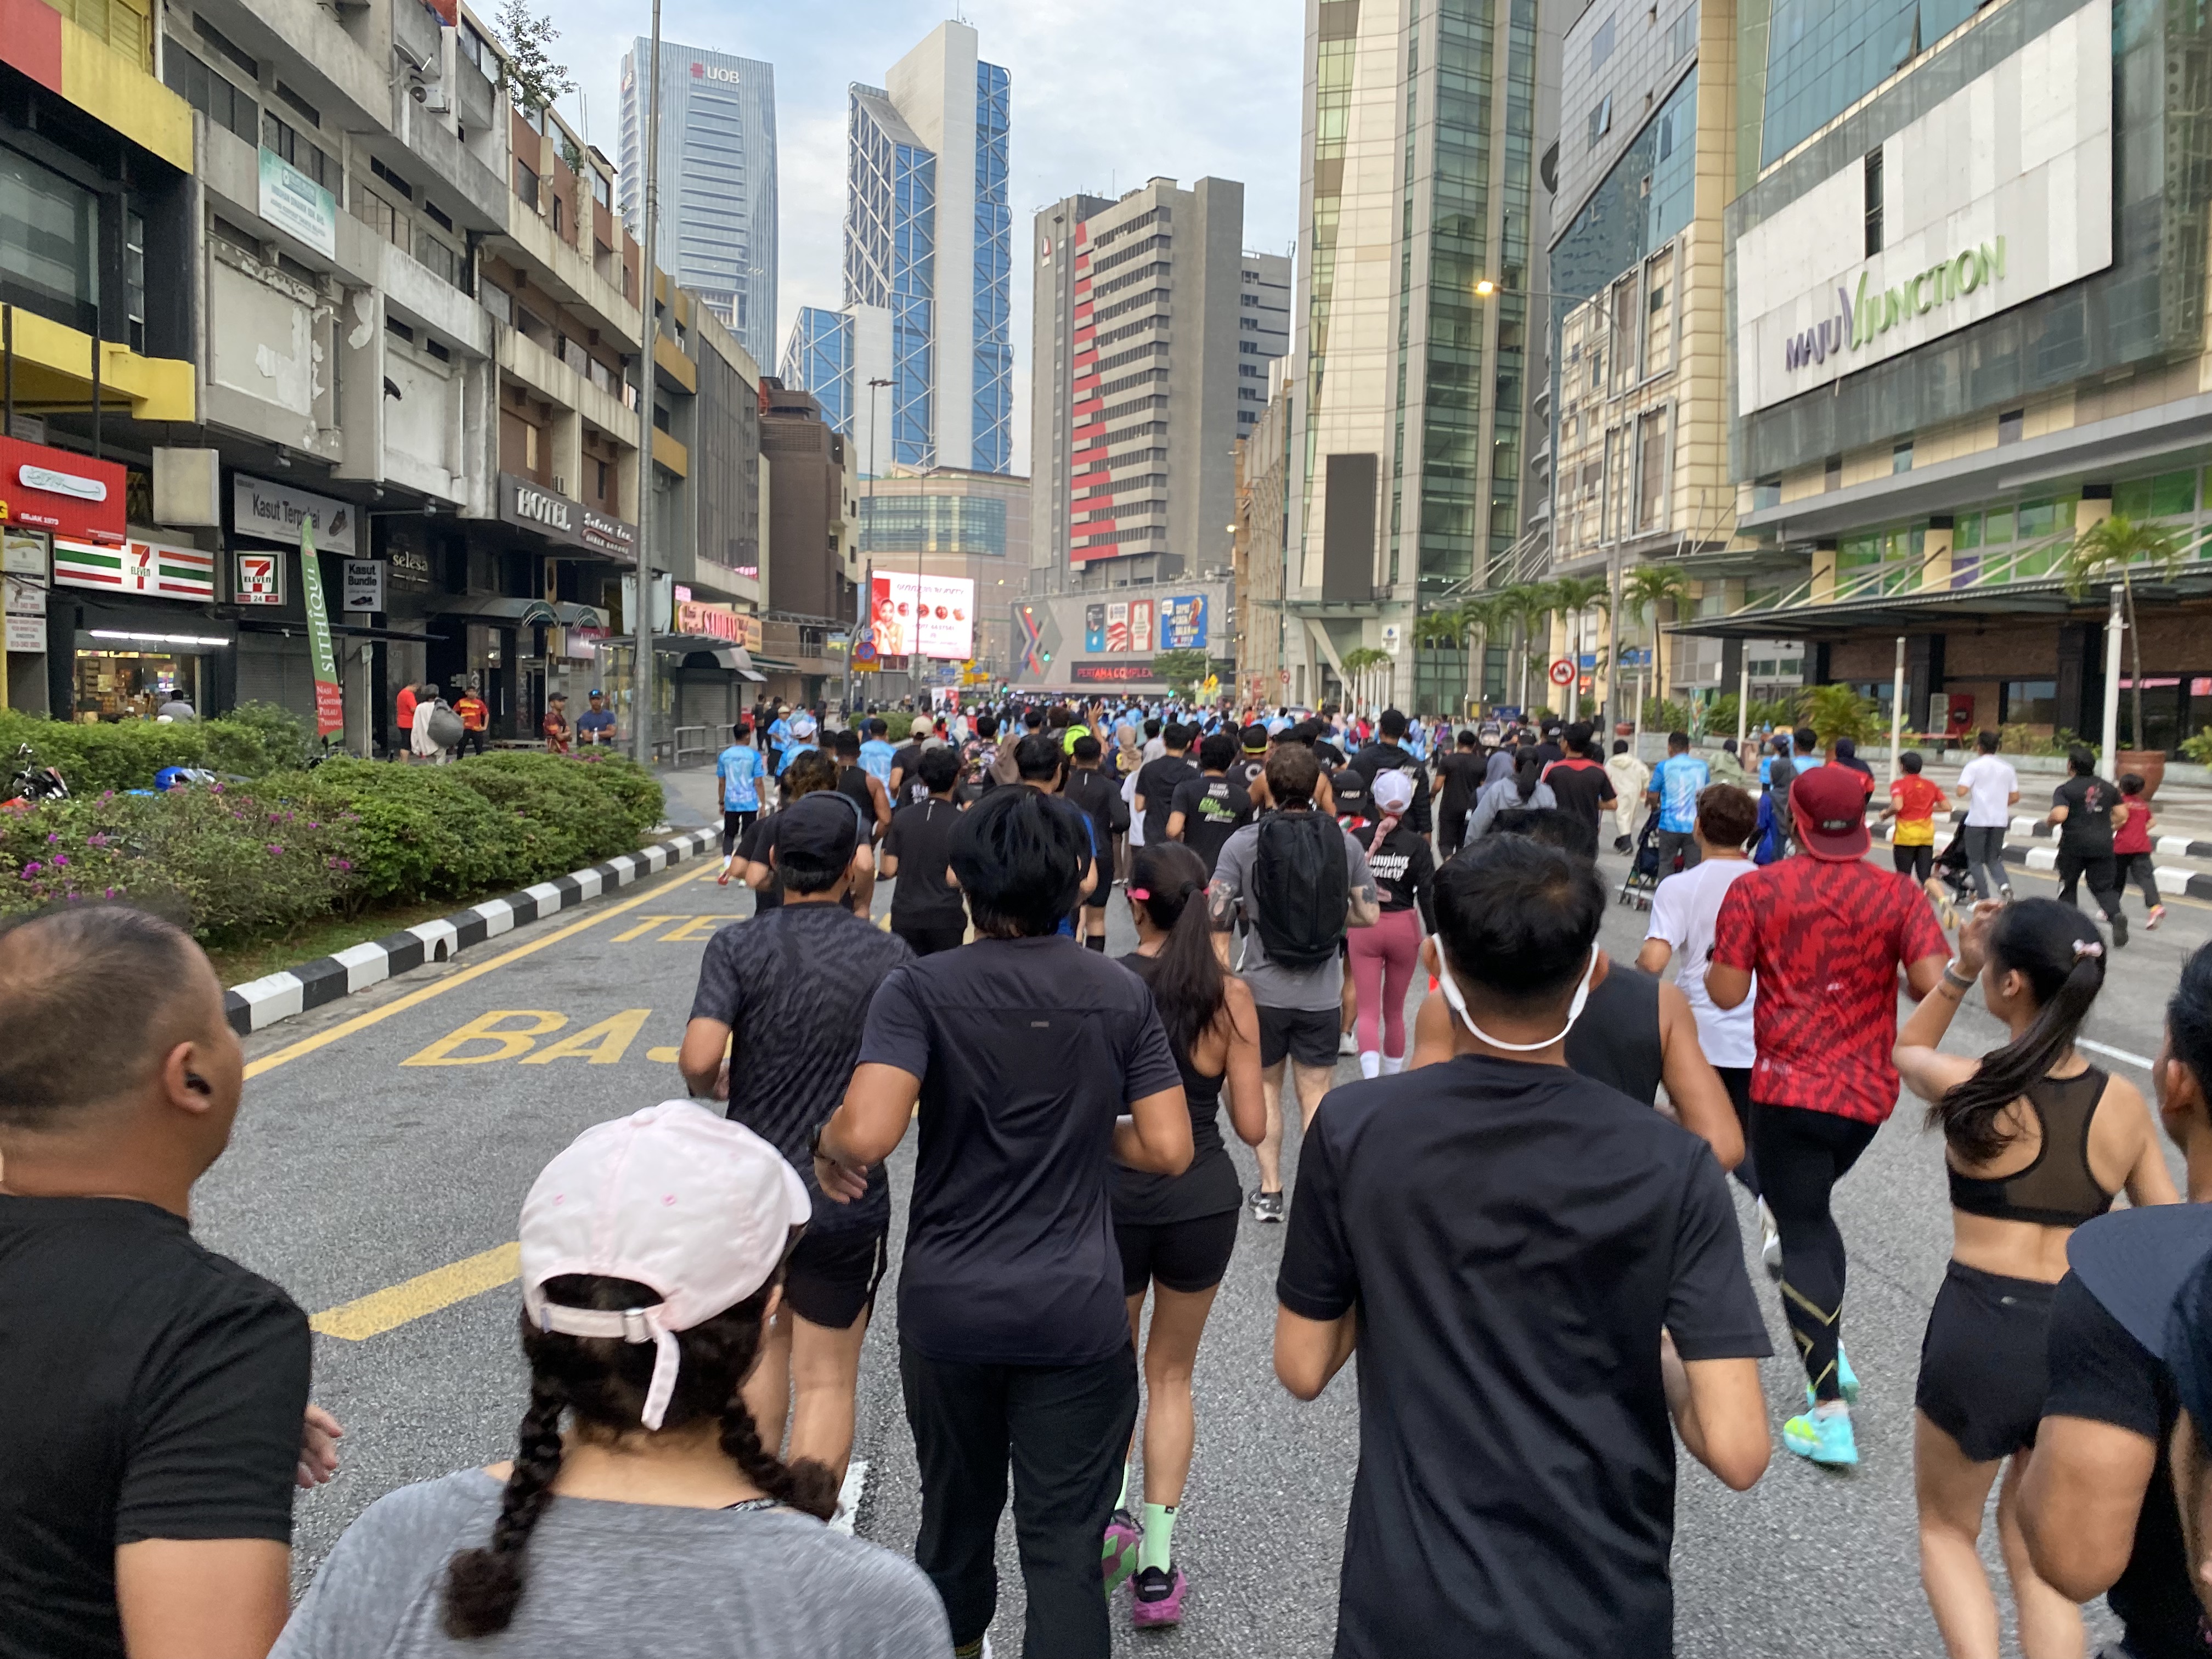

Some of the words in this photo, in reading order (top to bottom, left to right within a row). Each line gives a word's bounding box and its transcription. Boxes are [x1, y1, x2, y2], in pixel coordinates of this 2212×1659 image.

[707, 66, 740, 84] UOB
[1785, 315, 1842, 372] MAJU
[1865, 235, 2006, 344] JUNCTION
[252, 493, 280, 521] Kasut
[517, 487, 572, 532] HOTEL
[131, 543, 150, 589] 7
[348, 563, 376, 575] Kasut
[392, 551, 428, 571] selesa
[245, 560, 270, 592] 7
[348, 575, 377, 586] Bundle
[1077, 667, 1113, 679] PERTAMA
[1113, 667, 1153, 680] COMPLEX
[1369, 852, 1410, 870] unning
[1370, 866, 1406, 882] ociety
